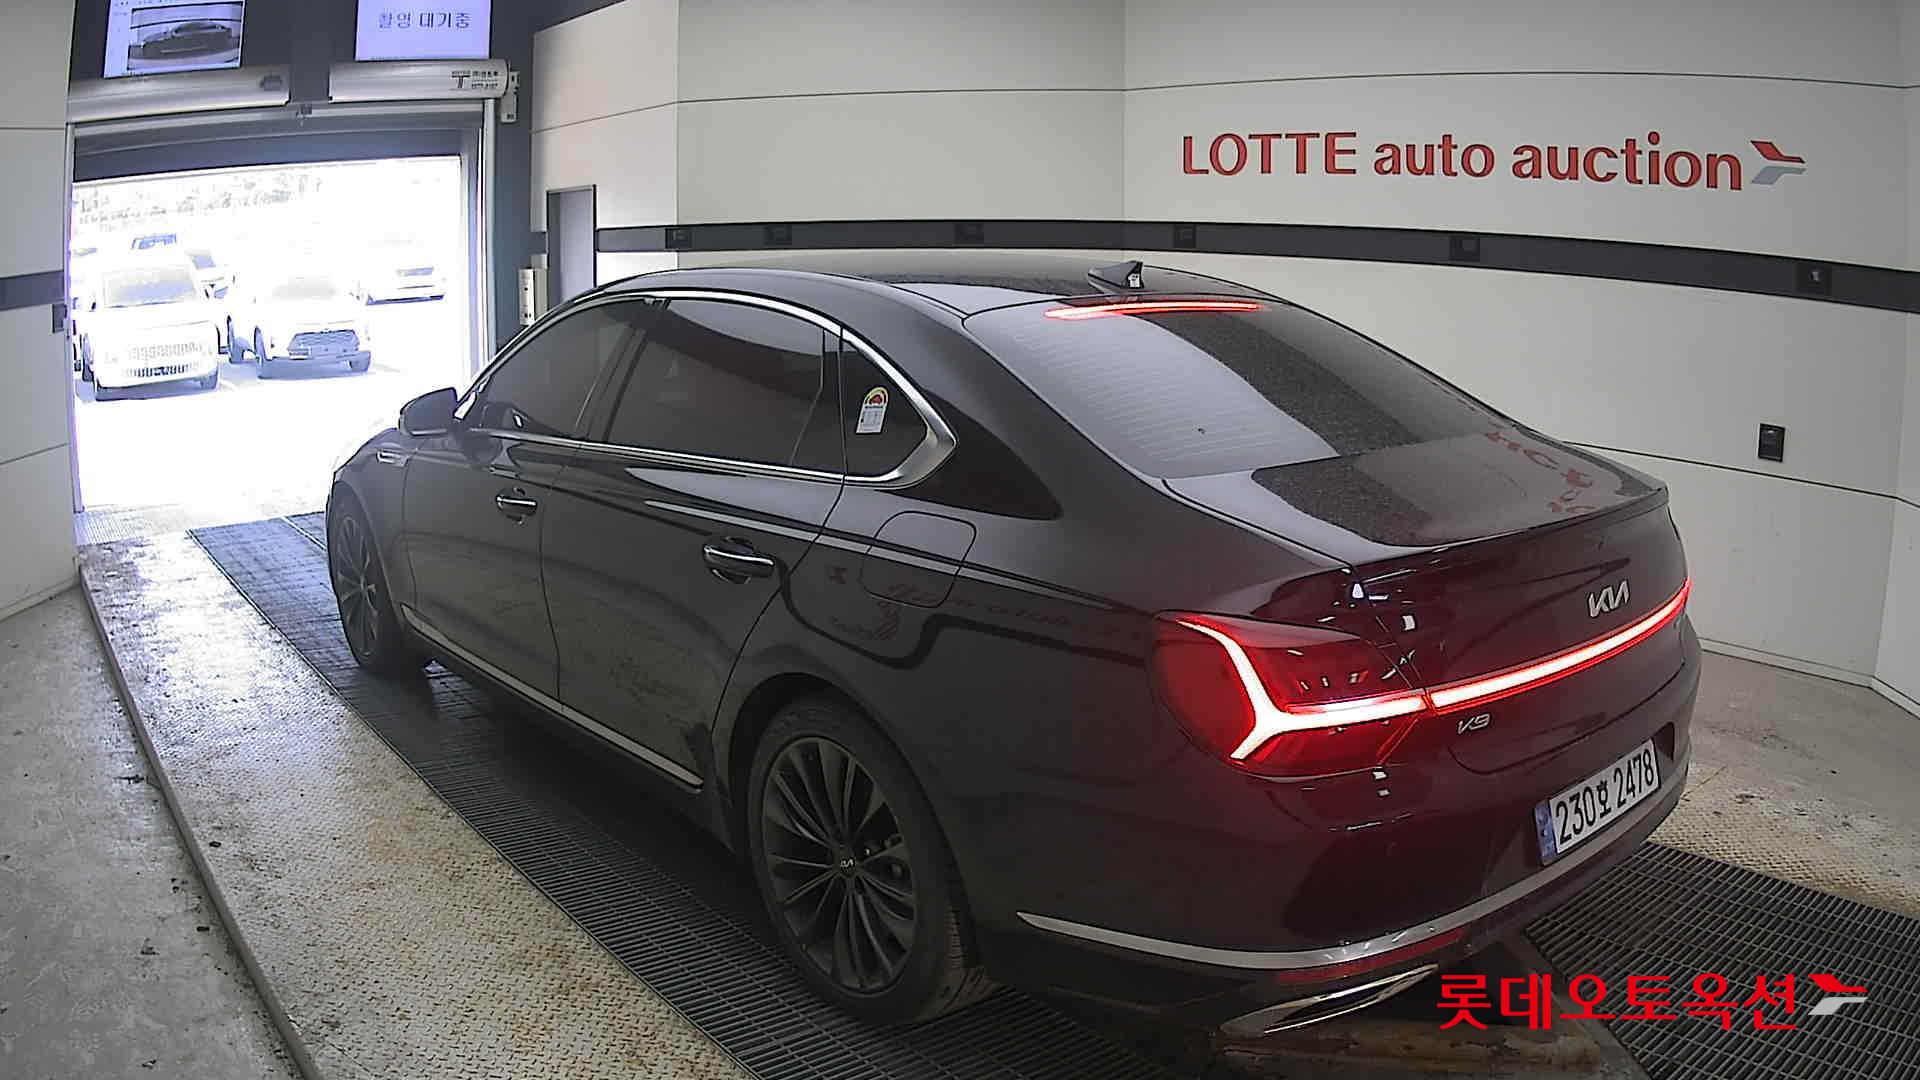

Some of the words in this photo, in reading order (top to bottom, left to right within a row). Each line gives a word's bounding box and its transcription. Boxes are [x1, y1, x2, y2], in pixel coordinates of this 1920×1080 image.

[419, 12, 469, 29] 대기중
[1182, 132, 1357, 176] LOTTE
[1374, 134, 1495, 177] auto
[1511, 131, 1742, 191] auction
[1458, 713, 1490, 734] K9
[1555, 780, 1612, 845] 230호
[1613, 748, 1655, 809] 2478
